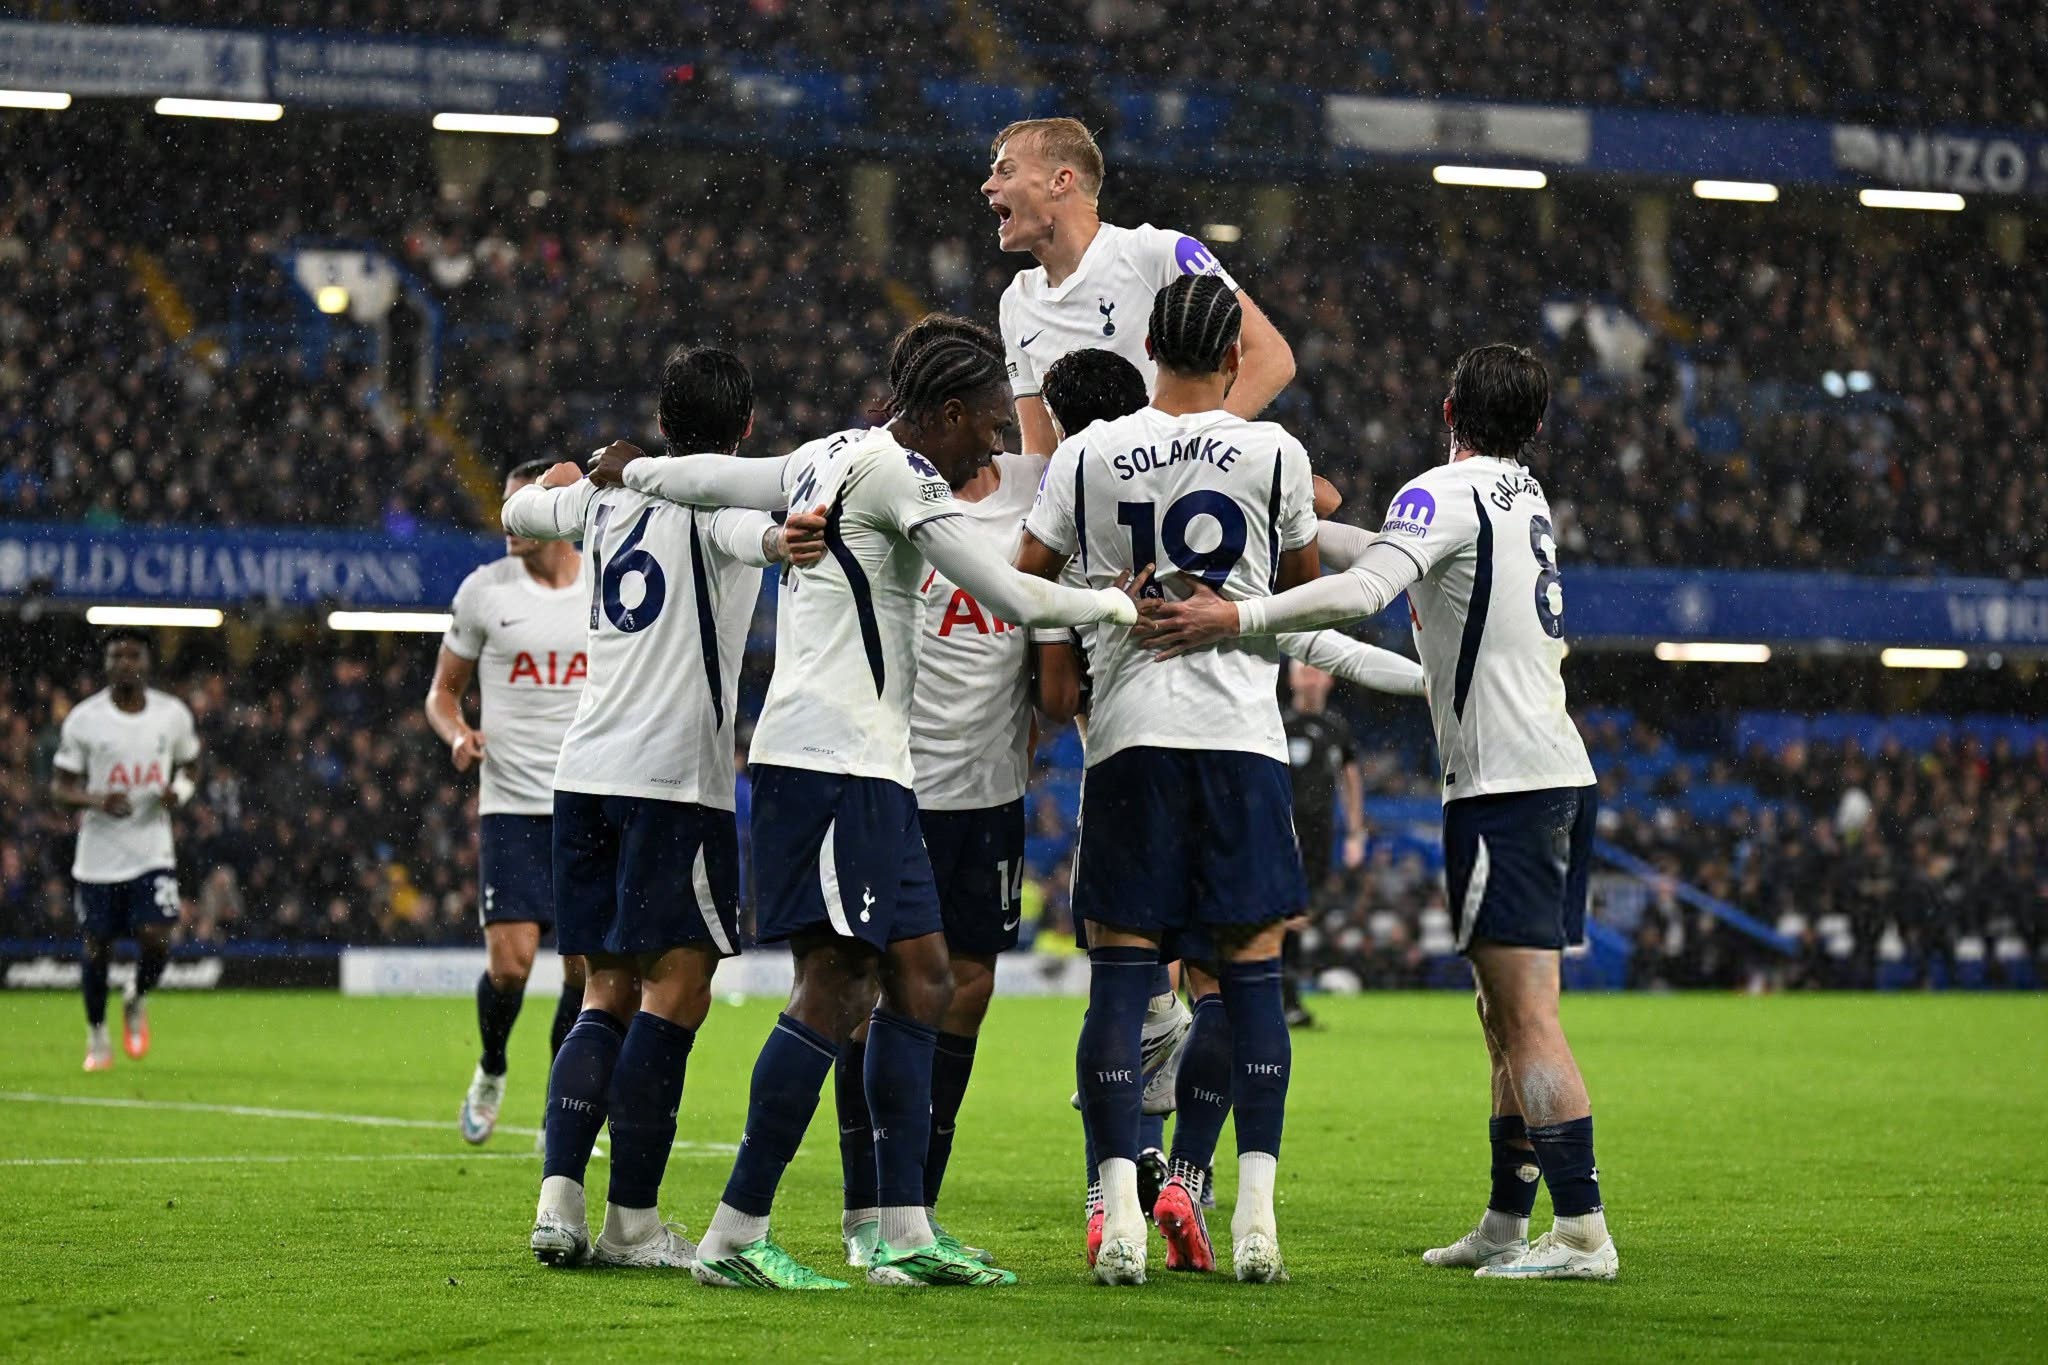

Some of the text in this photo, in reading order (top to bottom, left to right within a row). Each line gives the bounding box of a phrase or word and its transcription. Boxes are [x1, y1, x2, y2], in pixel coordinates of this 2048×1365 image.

[1113, 436, 1242, 480] SOLANKE
[1382, 519, 1428, 539] kraken
[1117, 489, 1248, 599] 19
[589, 503, 666, 633] 16
[1530, 514, 1564, 639] 8
[509, 652, 588, 685] AIA
[108, 762, 164, 787] AIA
[1097, 1070, 1133, 1084] THFC
[1244, 1063, 1282, 1077] THFC
[1192, 1087, 1224, 1107] THFC
